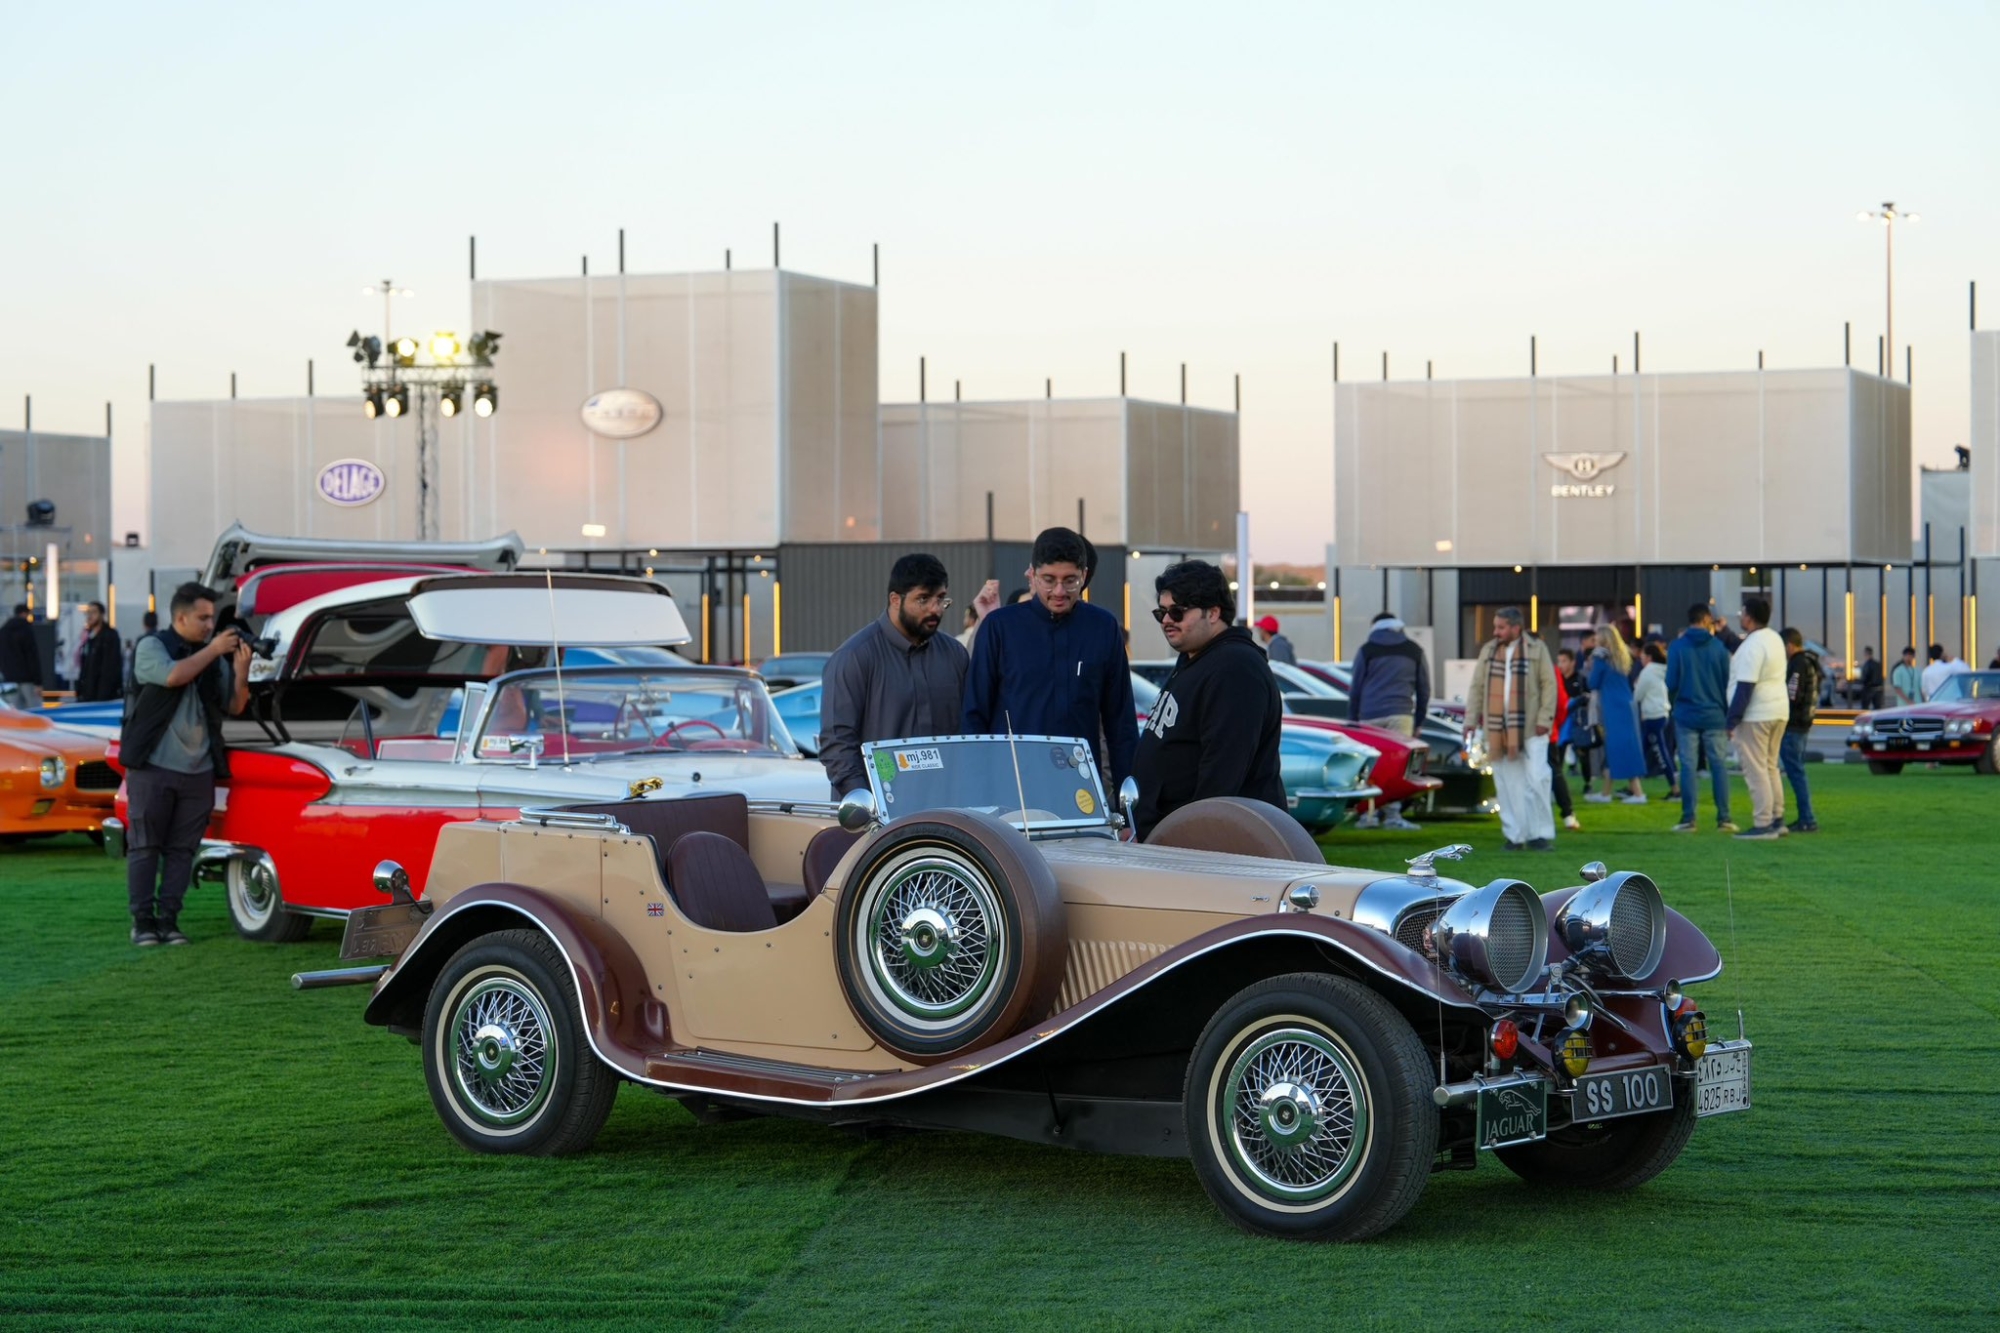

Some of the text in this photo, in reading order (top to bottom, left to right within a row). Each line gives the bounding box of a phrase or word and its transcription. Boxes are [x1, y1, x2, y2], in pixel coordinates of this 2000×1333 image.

[321, 464, 378, 500] DELAGE
[1551, 484, 1615, 497] BENTLEY
[906, 750, 939, 764] mj.981
[1587, 1072, 1659, 1114] SS 100
[1698, 1086, 1741, 1112] 4825 RBJ
[1484, 1113, 1534, 1144] JAGUAR
